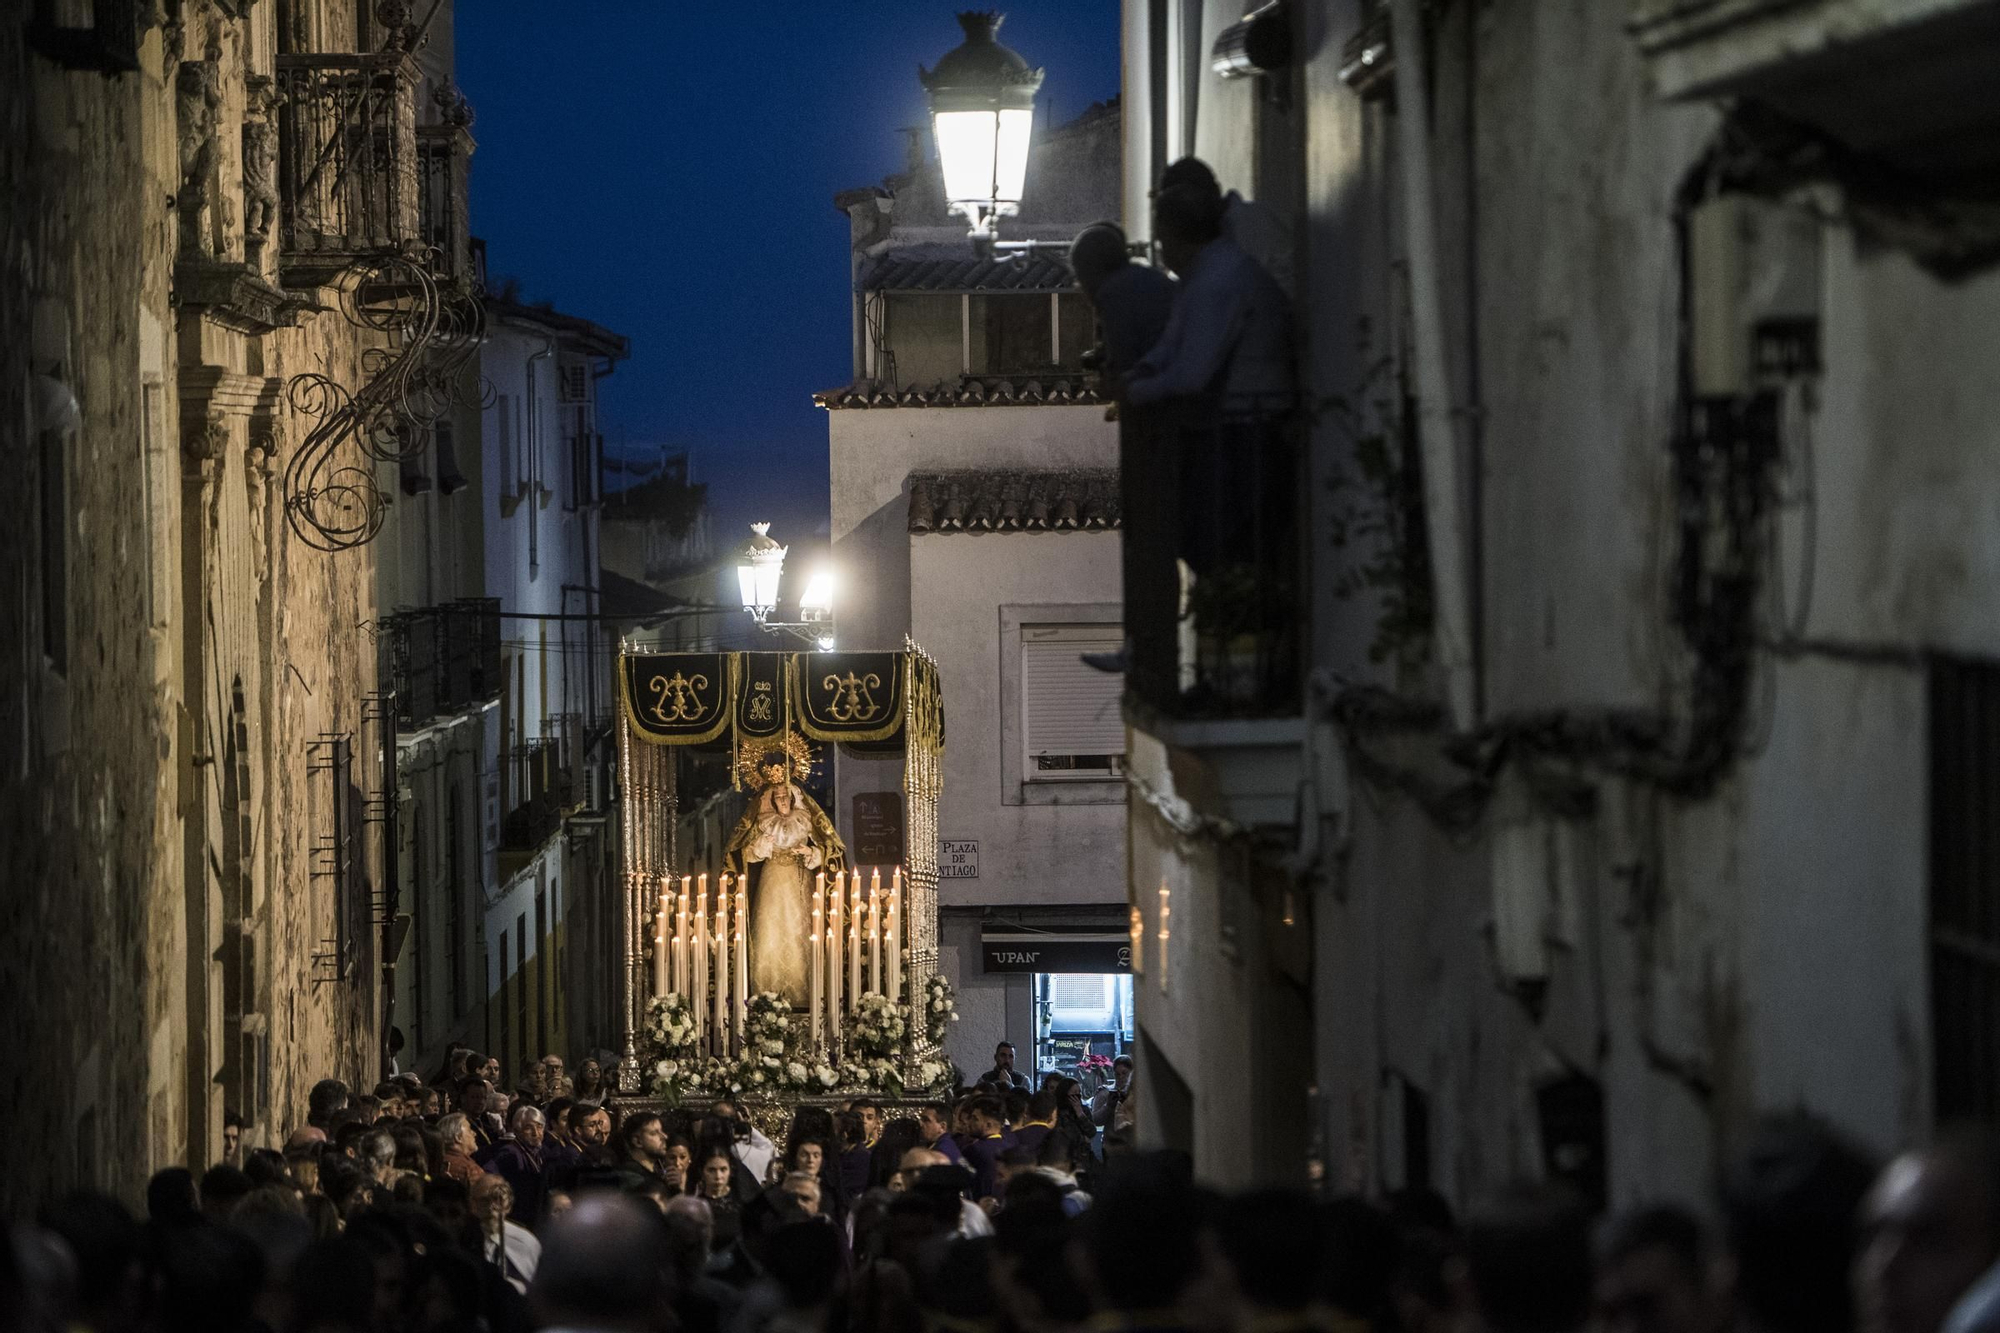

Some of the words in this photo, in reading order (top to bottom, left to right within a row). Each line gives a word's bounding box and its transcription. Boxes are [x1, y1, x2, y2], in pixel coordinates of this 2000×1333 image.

[943, 842, 977, 853] PLAZA
[952, 854, 966, 863] DE
[939, 865, 976, 876] NTIAGO
